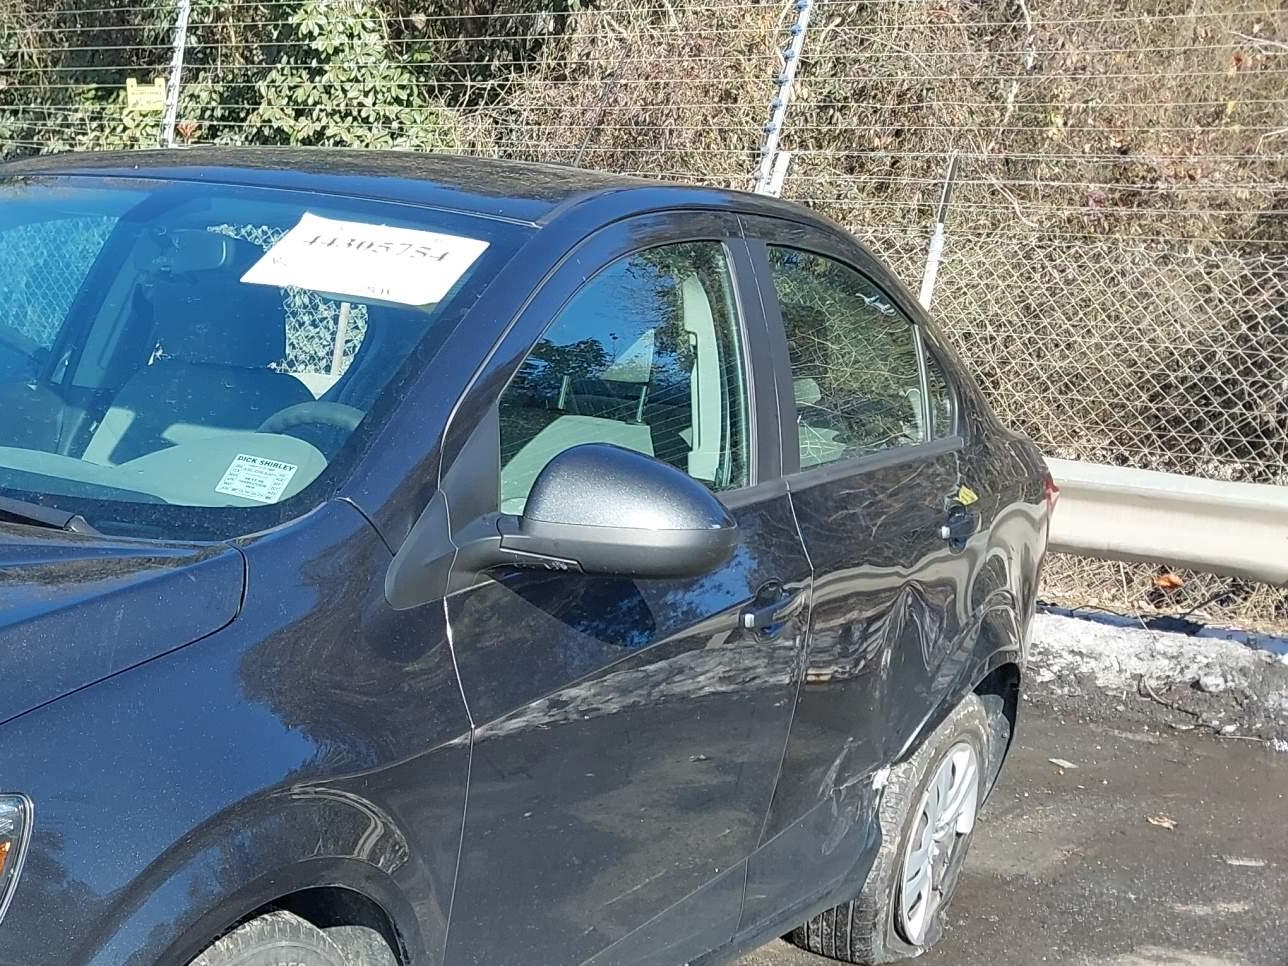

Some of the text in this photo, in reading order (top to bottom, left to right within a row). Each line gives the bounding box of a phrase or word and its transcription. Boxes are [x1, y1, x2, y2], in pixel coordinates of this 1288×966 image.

[303, 234, 450, 263] 44305754
[237, 455, 296, 472] DICK SHIRLEY
